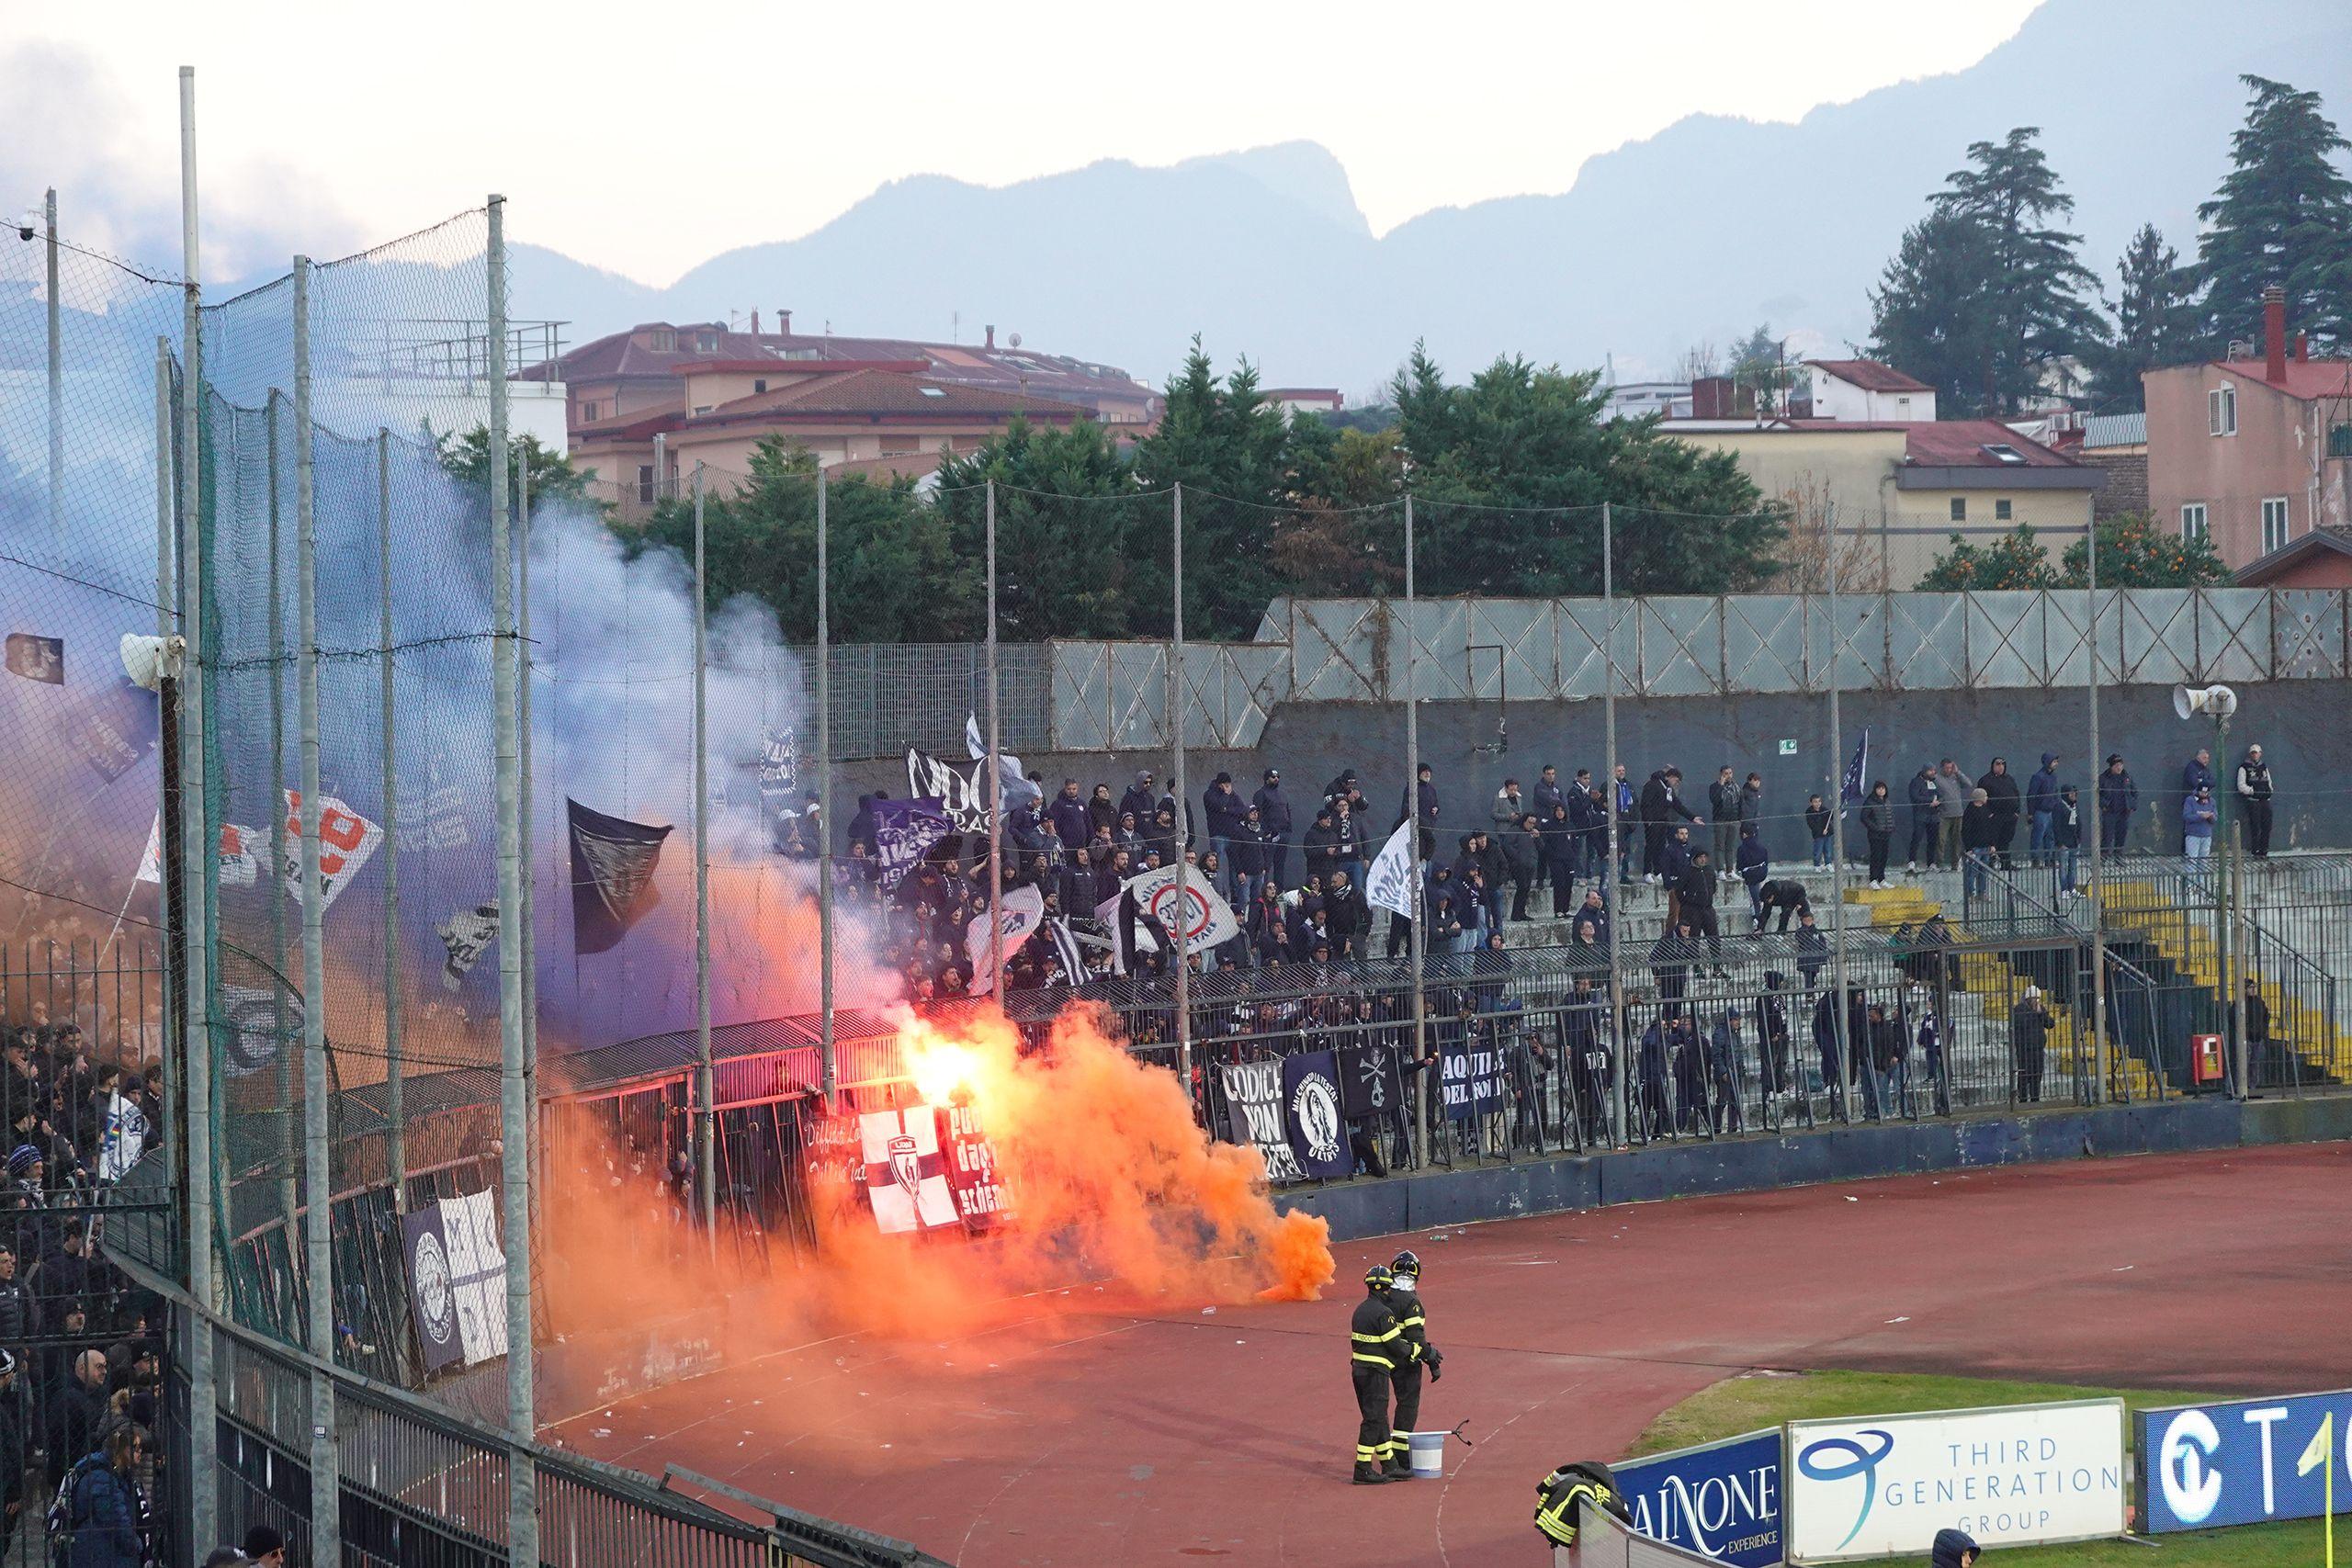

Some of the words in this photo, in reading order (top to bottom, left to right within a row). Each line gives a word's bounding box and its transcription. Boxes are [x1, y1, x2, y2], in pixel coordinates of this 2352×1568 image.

[1222, 1064, 1283, 1102] CODICE
[1242, 1102, 1282, 1142] NON
[1948, 1438, 2057, 1468] THIRD
[1885, 1466, 2118, 1506] GENERATION
[1623, 1464, 1778, 1557] AINONE
[1958, 1510, 2050, 1534] GROUP
[1727, 1529, 1779, 1554] EXPERIENCE
